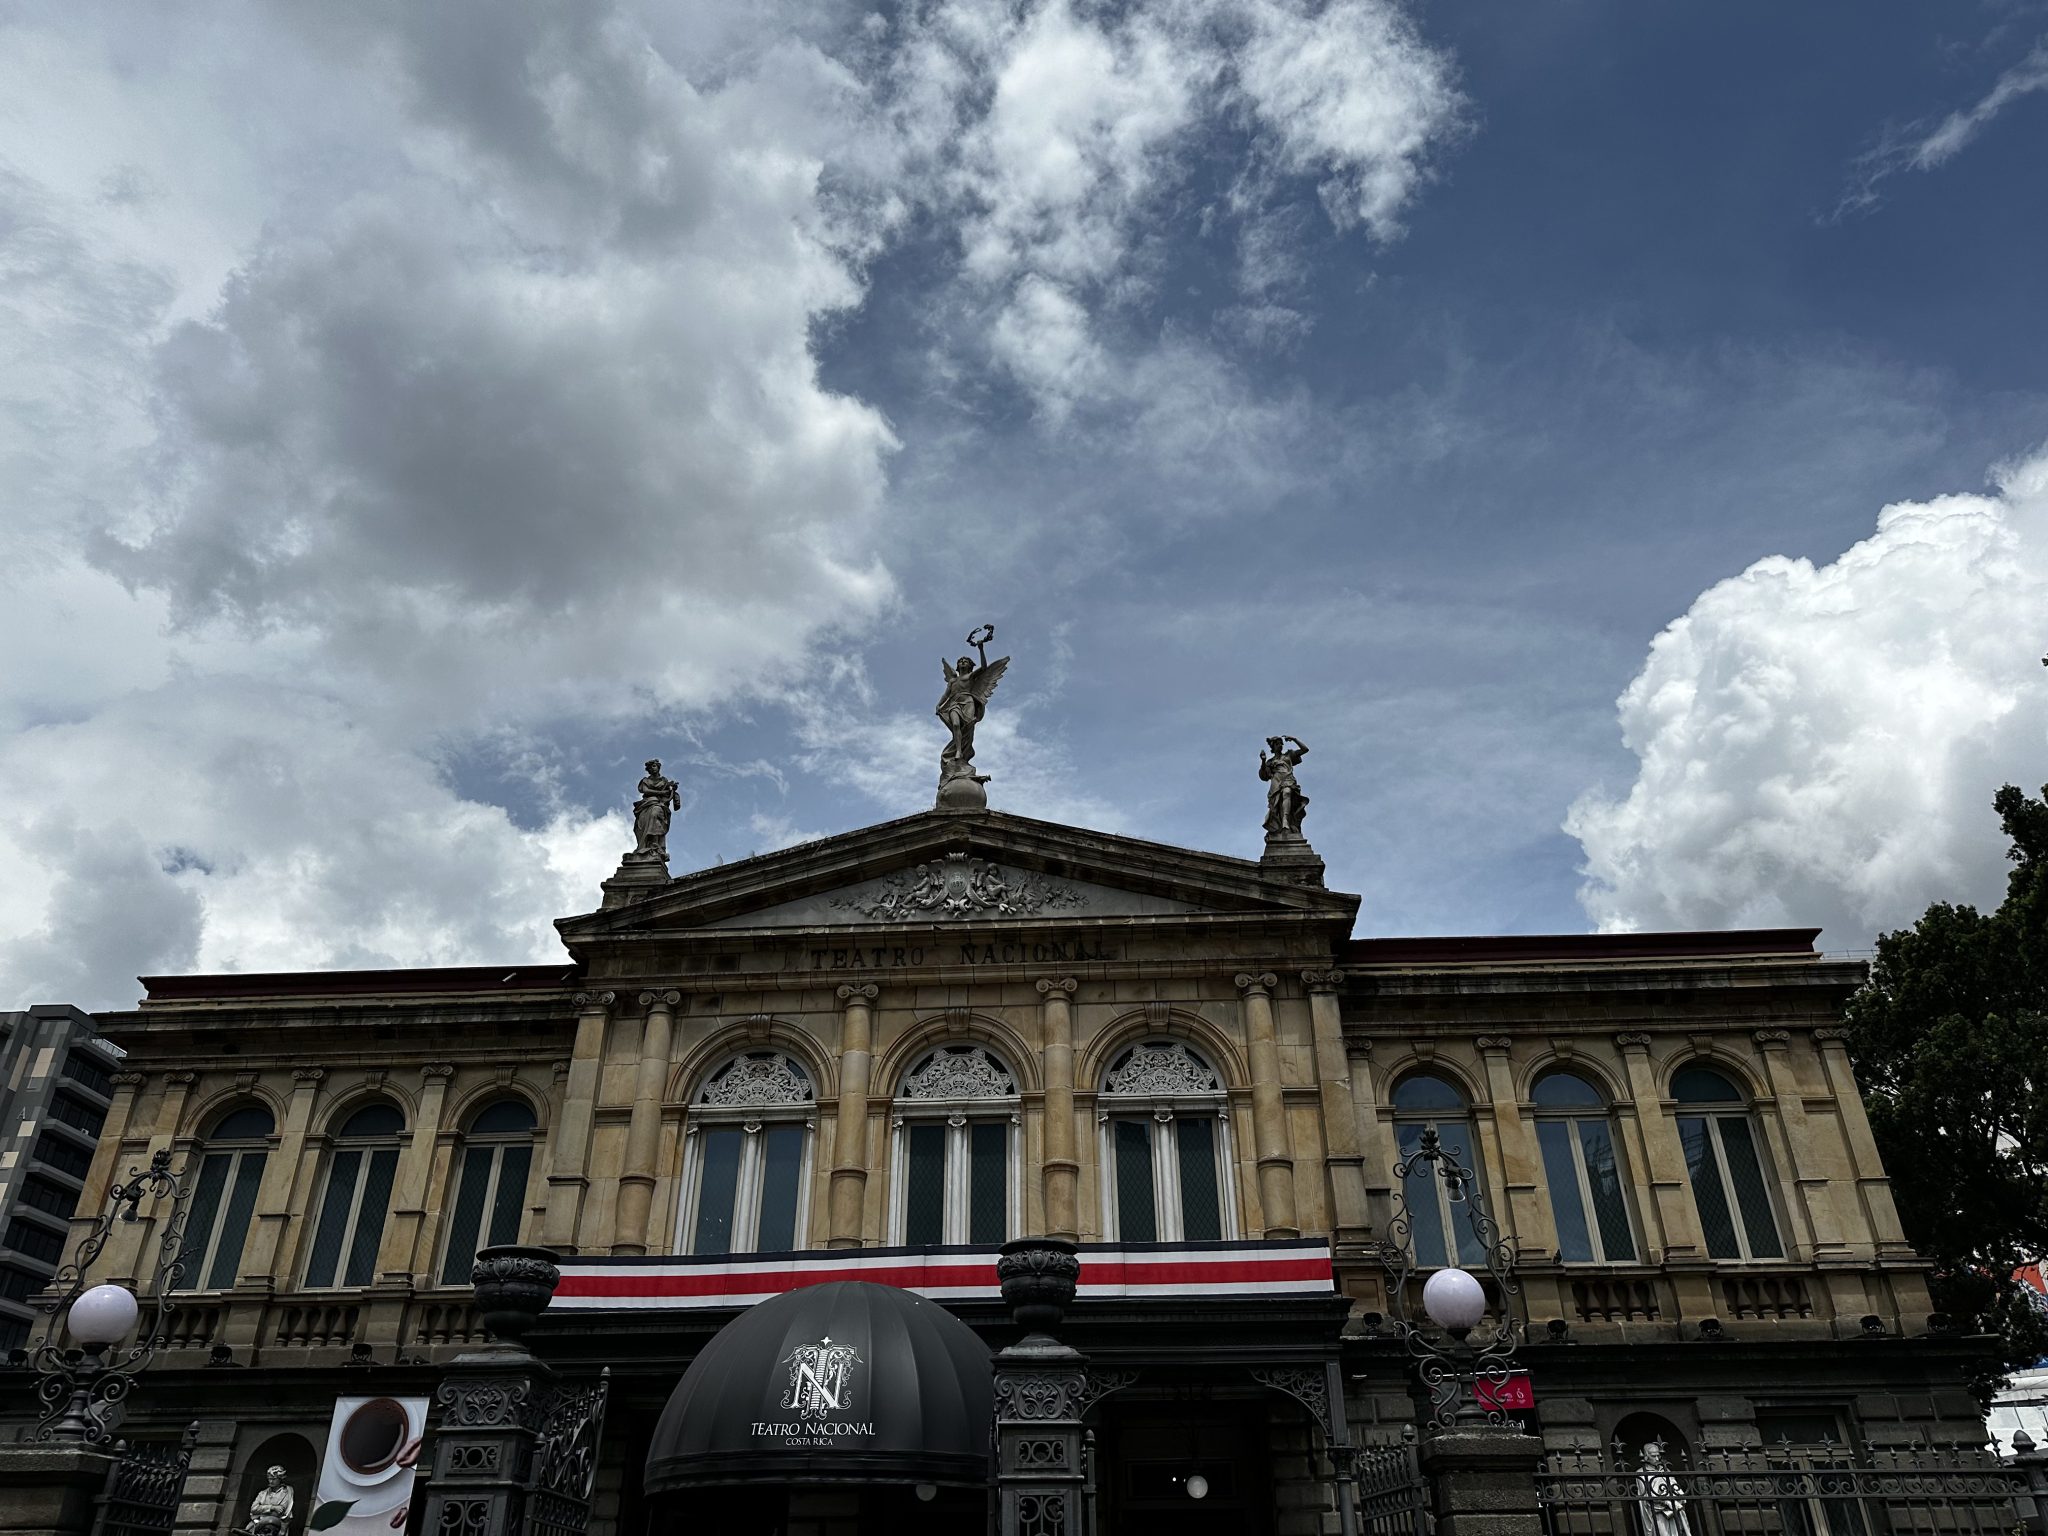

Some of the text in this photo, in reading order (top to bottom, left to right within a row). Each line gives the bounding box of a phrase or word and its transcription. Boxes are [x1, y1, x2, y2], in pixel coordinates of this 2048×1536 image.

[811, 941, 1110, 969] TEATRO NACIONAL
[751, 1422, 876, 1436] TEATRO NACIONAL
[785, 1437, 834, 1446] COSTA RICA
